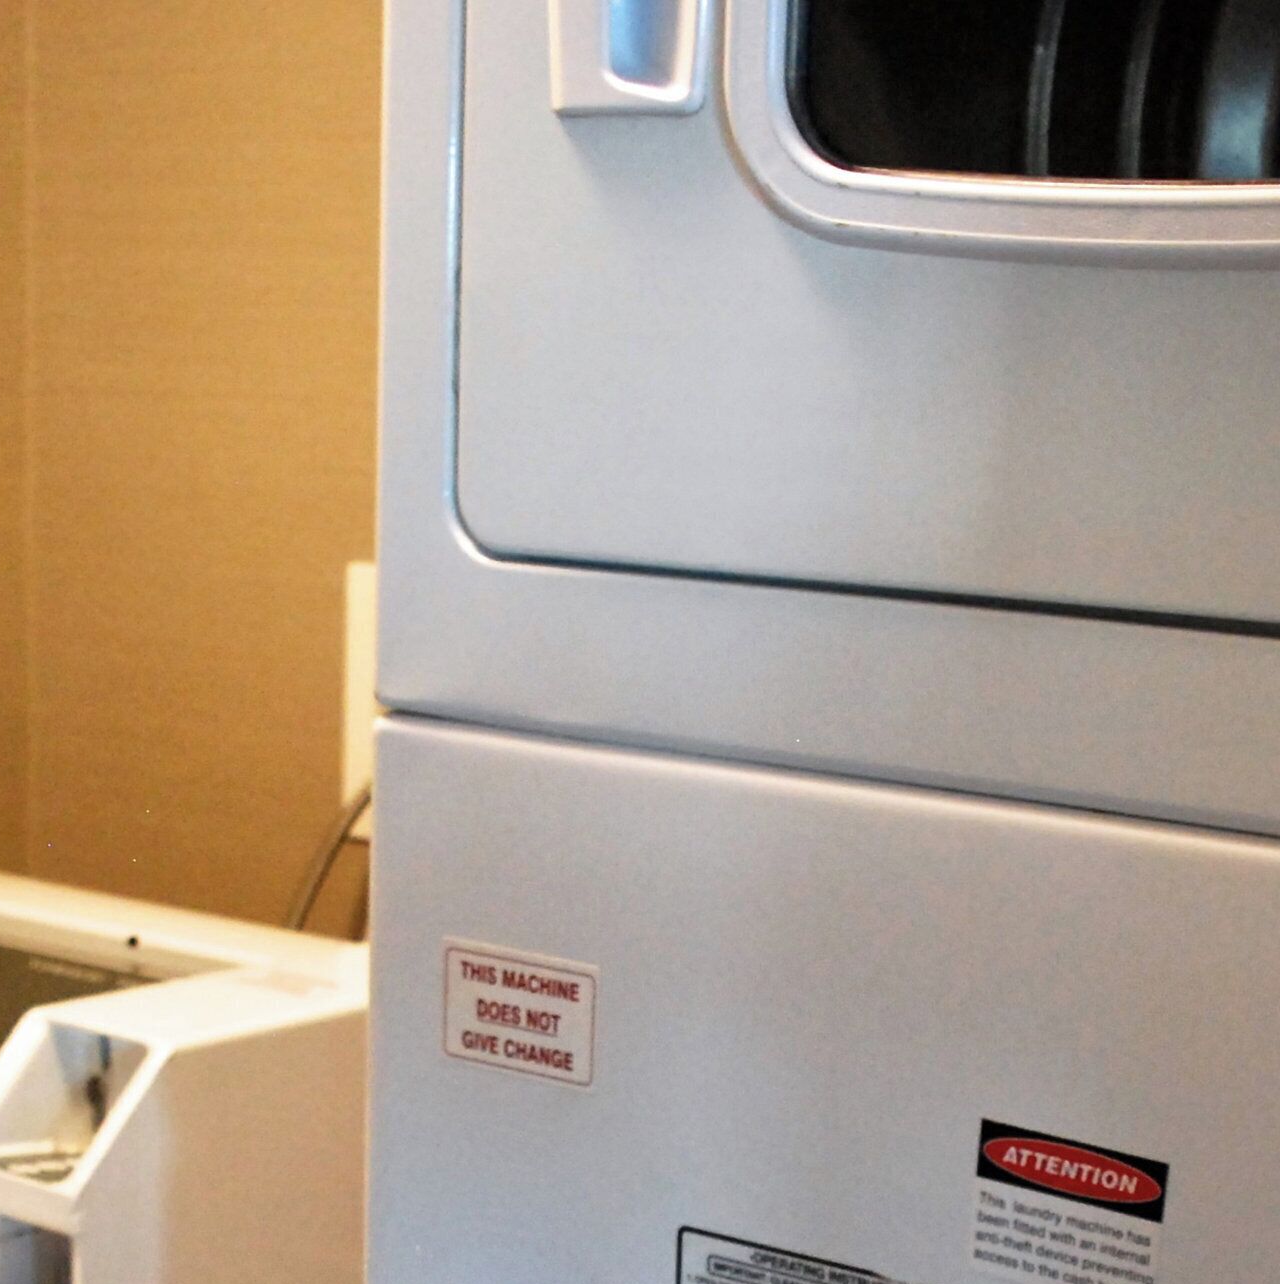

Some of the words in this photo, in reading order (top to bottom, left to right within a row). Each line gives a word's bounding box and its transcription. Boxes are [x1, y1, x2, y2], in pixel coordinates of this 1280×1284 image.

[461, 960, 497, 985] THIS
[502, 969, 580, 1002] MACHINE
[477, 998, 520, 1025] DOES
[526, 1009, 561, 1032] NOT
[461, 1031, 500, 1054] GIVE
[504, 1039, 573, 1071] CHANGE
[1002, 1147, 1138, 1194] ATTENTION
[977, 1210, 1010, 1228] been
[1013, 1219, 1046, 1238] fitted
[1049, 1229, 1076, 1246] with
[1080, 1239, 1096, 1251] an
[1099, 1242, 1151, 1266] internal
[980, 1190, 1006, 1210] This
[1014, 1200, 1063, 1226] laundry
[1066, 1216, 1124, 1240] machine
[1127, 1230, 1151, 1247] has
[973, 1249, 1019, 1269] access
[1022, 1259, 1035, 1273] to
[1038, 1263, 1059, 1280] the
[1035, 1245, 1078, 1265] device
